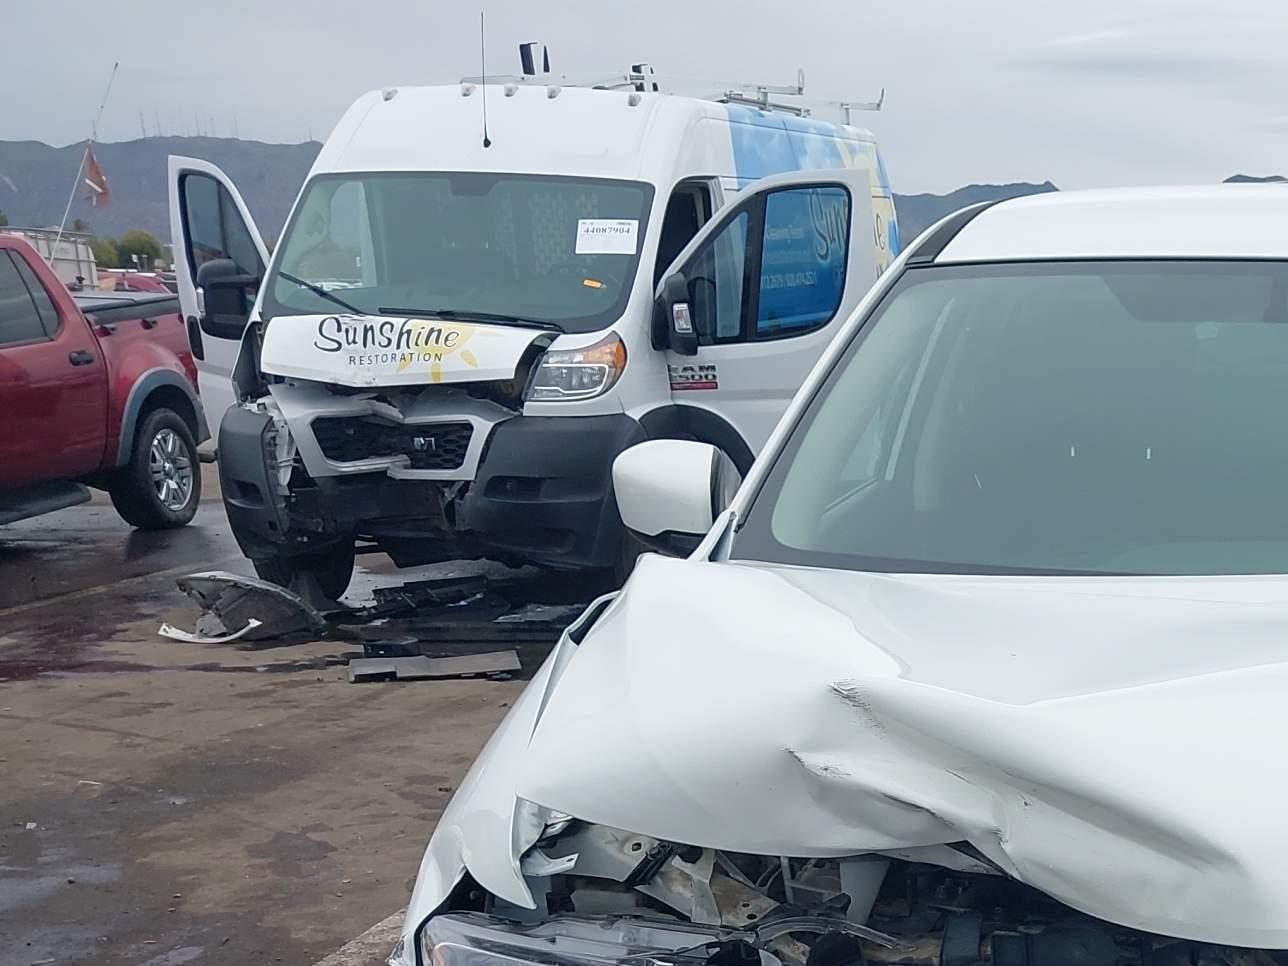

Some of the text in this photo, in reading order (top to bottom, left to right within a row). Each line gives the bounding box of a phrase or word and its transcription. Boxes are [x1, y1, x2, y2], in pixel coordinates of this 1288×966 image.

[583, 226, 630, 234] 44087904
[314, 316, 460, 352] Sunshine
[348, 352, 443, 365] RESTORATION
